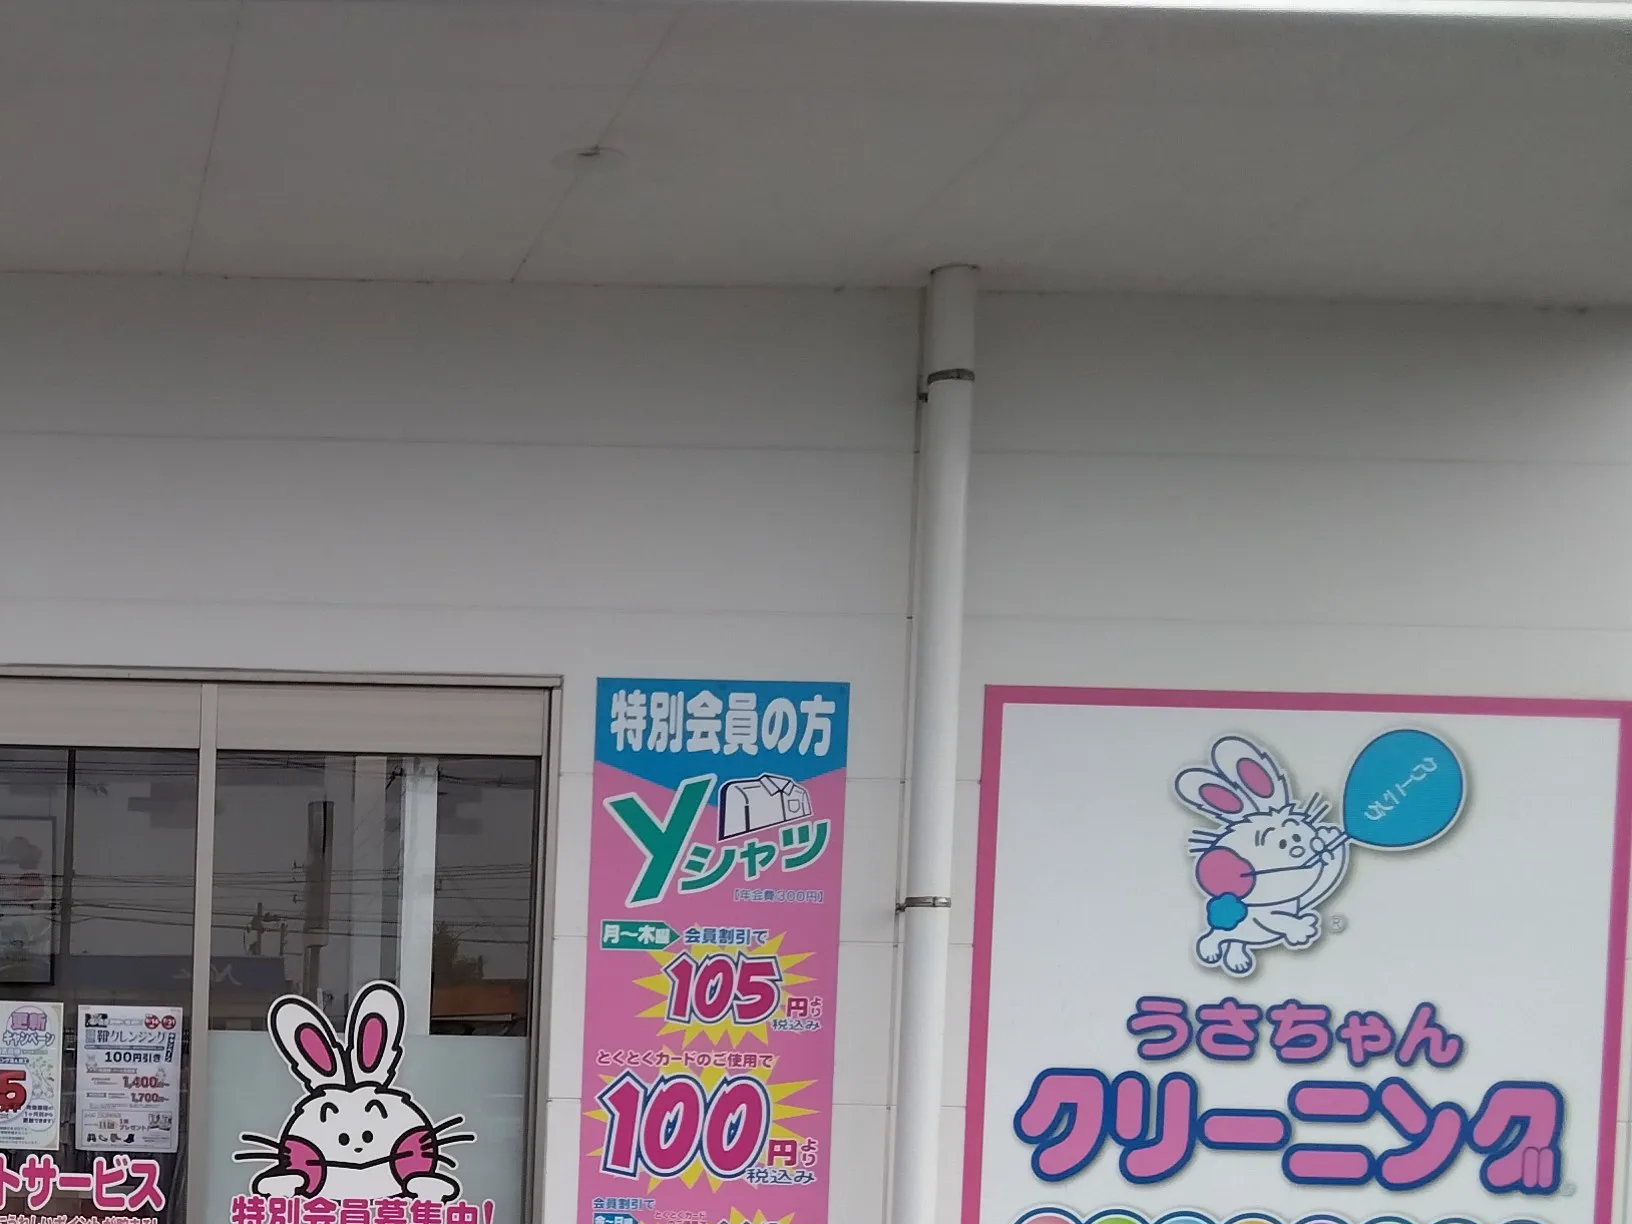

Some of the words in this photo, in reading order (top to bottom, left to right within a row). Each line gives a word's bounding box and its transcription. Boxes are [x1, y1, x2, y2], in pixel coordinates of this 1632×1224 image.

[611, 688, 837, 758] 特別会員の方
[684, 927, 768, 945] 会員割引で
[771, 1018, 821, 1032] 税込み
[1127, 996, 1464, 1068] うさちゃん
[3, 1031, 56, 1047] キャンペーン
[105, 1051, 161, 1063] 100円引き
[596, 1050, 775, 1068] とくとくカードのご使用で
[1013, 1067, 1566, 1195] クリーニング
[745, 1168, 816, 1185] 税込み
[592, 1196, 657, 1210] 会員割引で
